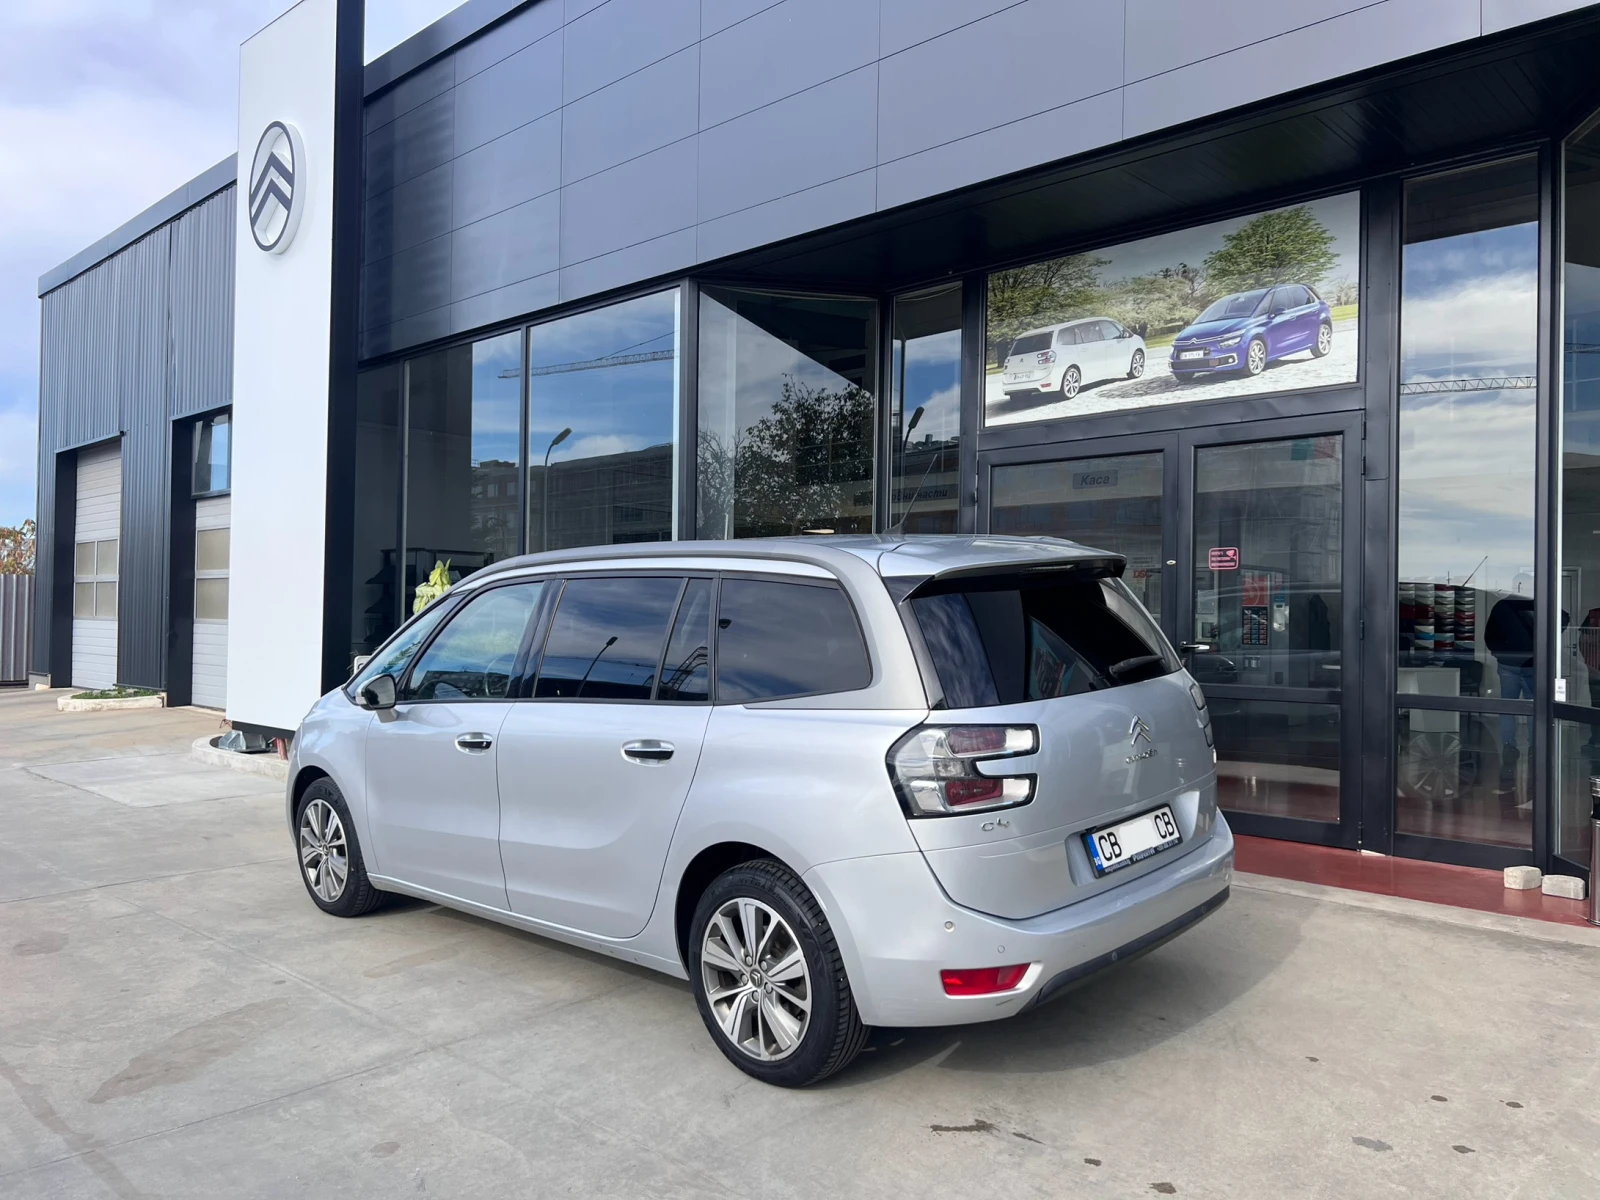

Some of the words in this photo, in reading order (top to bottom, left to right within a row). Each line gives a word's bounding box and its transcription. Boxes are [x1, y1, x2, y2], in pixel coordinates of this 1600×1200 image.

[1080, 475, 1110, 486] Каса
[917, 489, 948, 499] части
[981, 817, 1010, 832] C4
[1154, 812, 1175, 839] CB
[1098, 832, 1122, 861] CB
